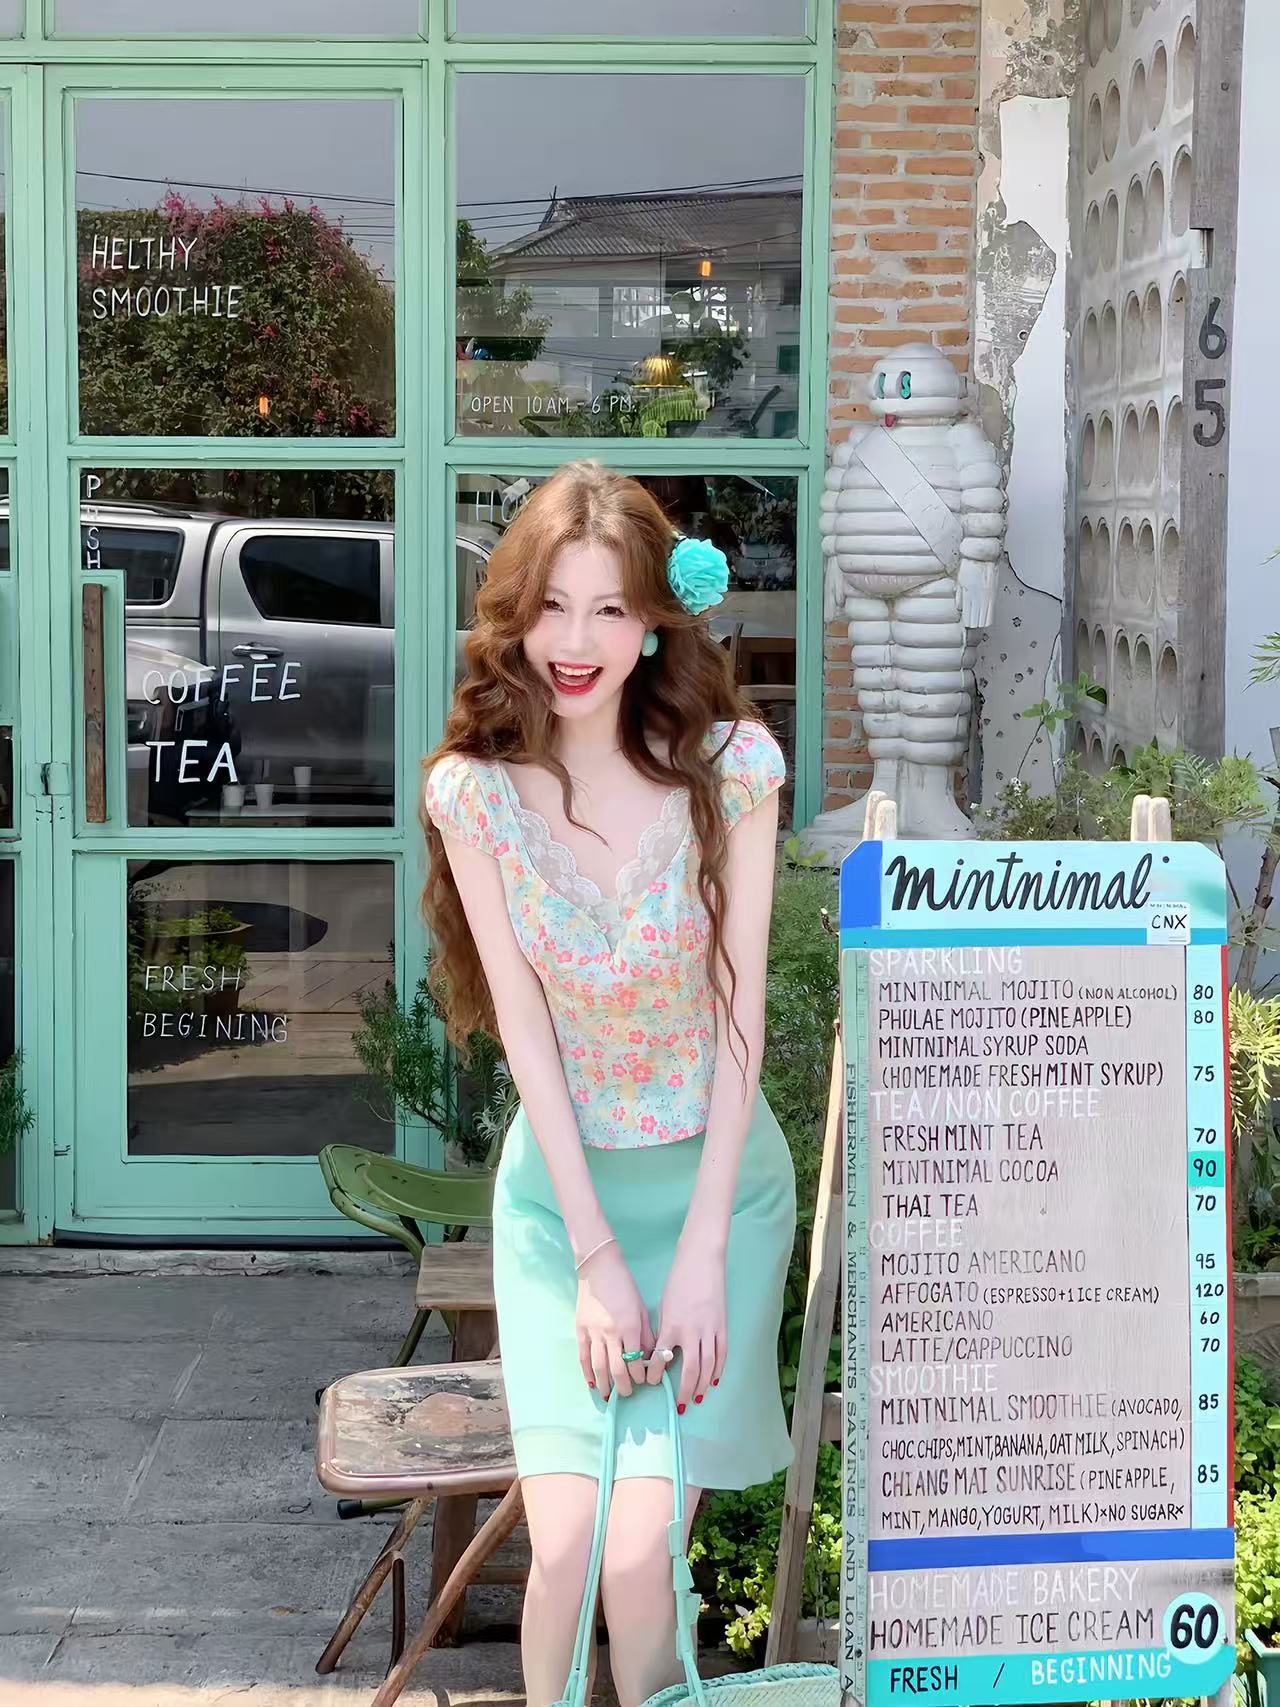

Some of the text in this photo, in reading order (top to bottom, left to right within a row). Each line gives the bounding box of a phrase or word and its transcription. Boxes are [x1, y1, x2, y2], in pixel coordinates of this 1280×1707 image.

[91, 234, 199, 271] HELTHY
[92, 285, 243, 319] SMOOTHIE
[471, 395, 513, 413] OPEN
[591, 395, 601, 414] 6
[86, 474, 101, 569] PSH
[142, 662, 302, 705] COFFEE
[145, 739, 238, 784] TEA
[1151, 914, 1188, 930] CNX
[870, 945, 1023, 977] SPARKLING
[144, 965, 242, 992] FRESH
[878, 980, 992, 1002] MINTNIMAL
[1001, 979, 1074, 1001] MOJITO
[1193, 984, 1214, 1000] 80
[143, 1012, 288, 1043] BEGINING
[879, 1008, 945, 1030] PHULAE
[1193, 1009, 1214, 1025] 80
[879, 1034, 1089, 1058] MINTNIMAL SYRUP SODA
[882, 1064, 983, 1088] (HOMEMADE
[1101, 1061, 1164, 1086] SYRUP)
[1193, 1065, 1215, 1082] 75
[1009, 1088, 1101, 1119] COFFEE
[846, 1062, 857, 1208] FISHERMEN
[1002, 1123, 1044, 1151] TEA
[1194, 1127, 1217, 1144] 70
[882, 1159, 1059, 1185] MINTNIMAL COCOA
[1193, 1158, 1217, 1177] 90
[883, 1193, 932, 1218] THAI
[940, 1193, 979, 1217] TEA
[1195, 1194, 1217, 1211] 70
[869, 1218, 965, 1249] COFFEE
[881, 1250, 1087, 1276] MOJITO AMERICANO
[1195, 1253, 1216, 1270] 95
[881, 1281, 979, 1304] AFFOGATO
[1106, 1286, 1160, 1304] CREAM)
[1195, 1283, 1225, 1298] 120
[846, 1251, 857, 1389] MERCHANTS
[881, 1309, 994, 1333] AMERICANO
[1200, 1310, 1220, 1325] 60
[1200, 1337, 1221, 1353] 70
[869, 1364, 999, 1396] SMOOTHIE
[880, 1396, 1001, 1425] MINTNIMAL
[1008, 1393, 1108, 1421] SMOOTHIE
[1198, 1393, 1219, 1411] 85
[846, 1401, 857, 1517] SAVINGS
[882, 1468, 949, 1498] CHIANG
[954, 1467, 988, 1496] MAI
[996, 1463, 1076, 1494] SUNRISE
[1197, 1464, 1219, 1484] 85
[845, 1530, 856, 1582] AND
[870, 1571, 1019, 1612] HOMEMADE
[1033, 1567, 1140, 1606] BAKERY
[844, 1595, 855, 1661] LOAN
[870, 1607, 1155, 1650] HOMEMADE ICE CREAM
[1170, 1603, 1219, 1649] 60
[890, 1664, 958, 1694] FRESH
[1031, 1650, 1173, 1685] BEGINNING
